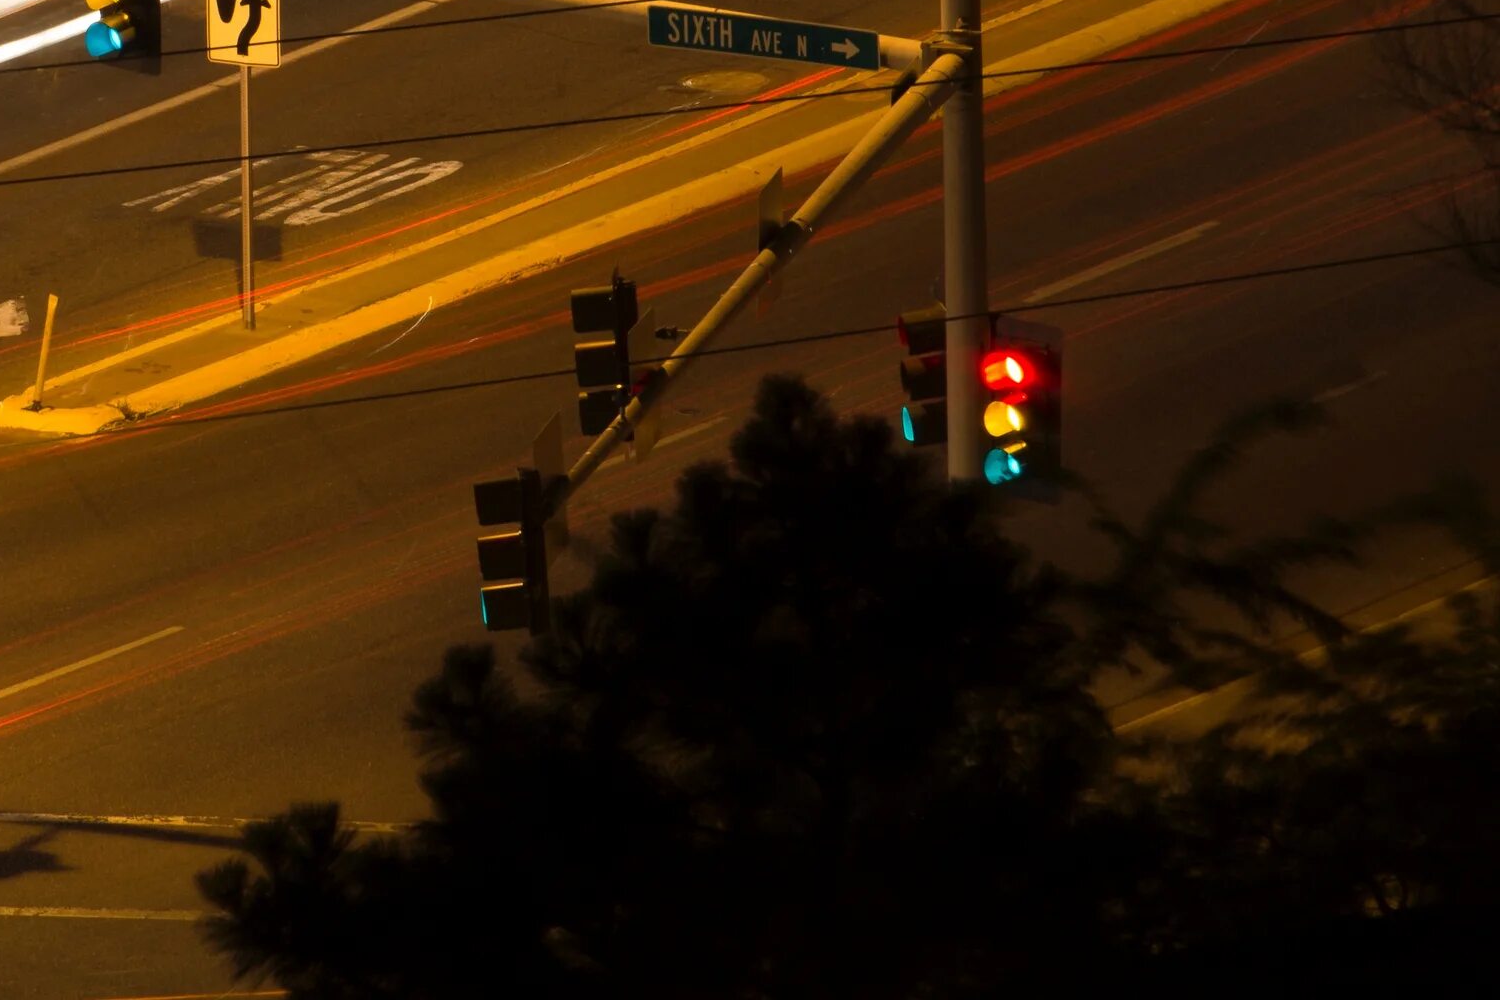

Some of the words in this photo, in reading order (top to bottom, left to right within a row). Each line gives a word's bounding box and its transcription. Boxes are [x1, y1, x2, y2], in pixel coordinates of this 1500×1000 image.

[668, 12, 733, 49] SIXTH
[750, 29, 783, 55] AVE
[797, 34, 808, 57] N
